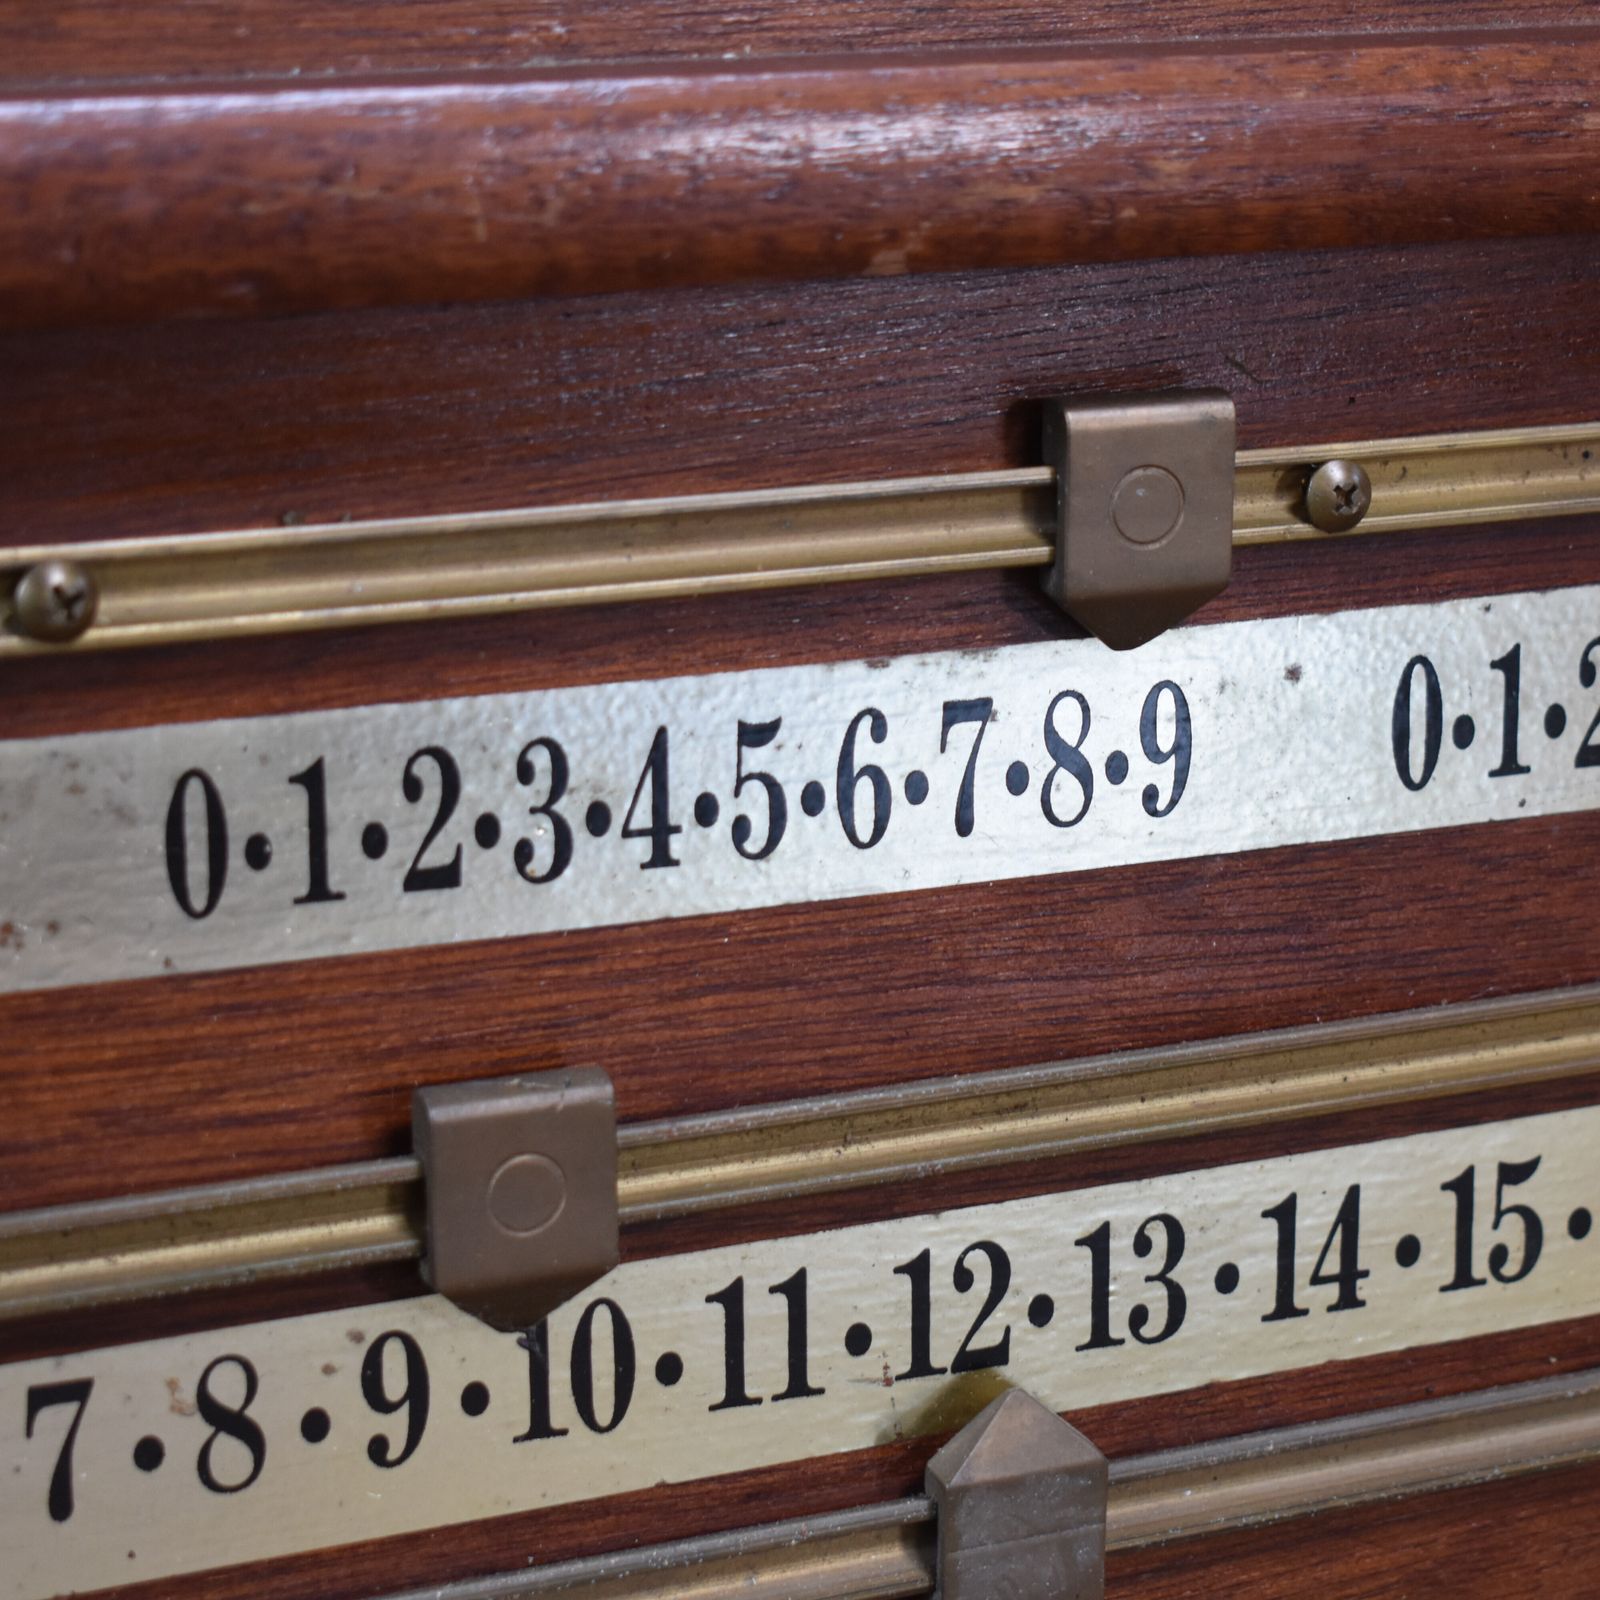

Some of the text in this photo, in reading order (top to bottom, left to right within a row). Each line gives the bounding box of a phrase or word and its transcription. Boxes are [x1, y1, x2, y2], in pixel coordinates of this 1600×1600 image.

[165, 680, 1192, 919] 0 1 2 3 4 5 6 7 8 9
[1392, 655, 1443, 791] 0
[1489, 643, 1531, 777] 1
[26, 1155, 1543, 1523] 7 8 9 10 11 12 13 14 15
